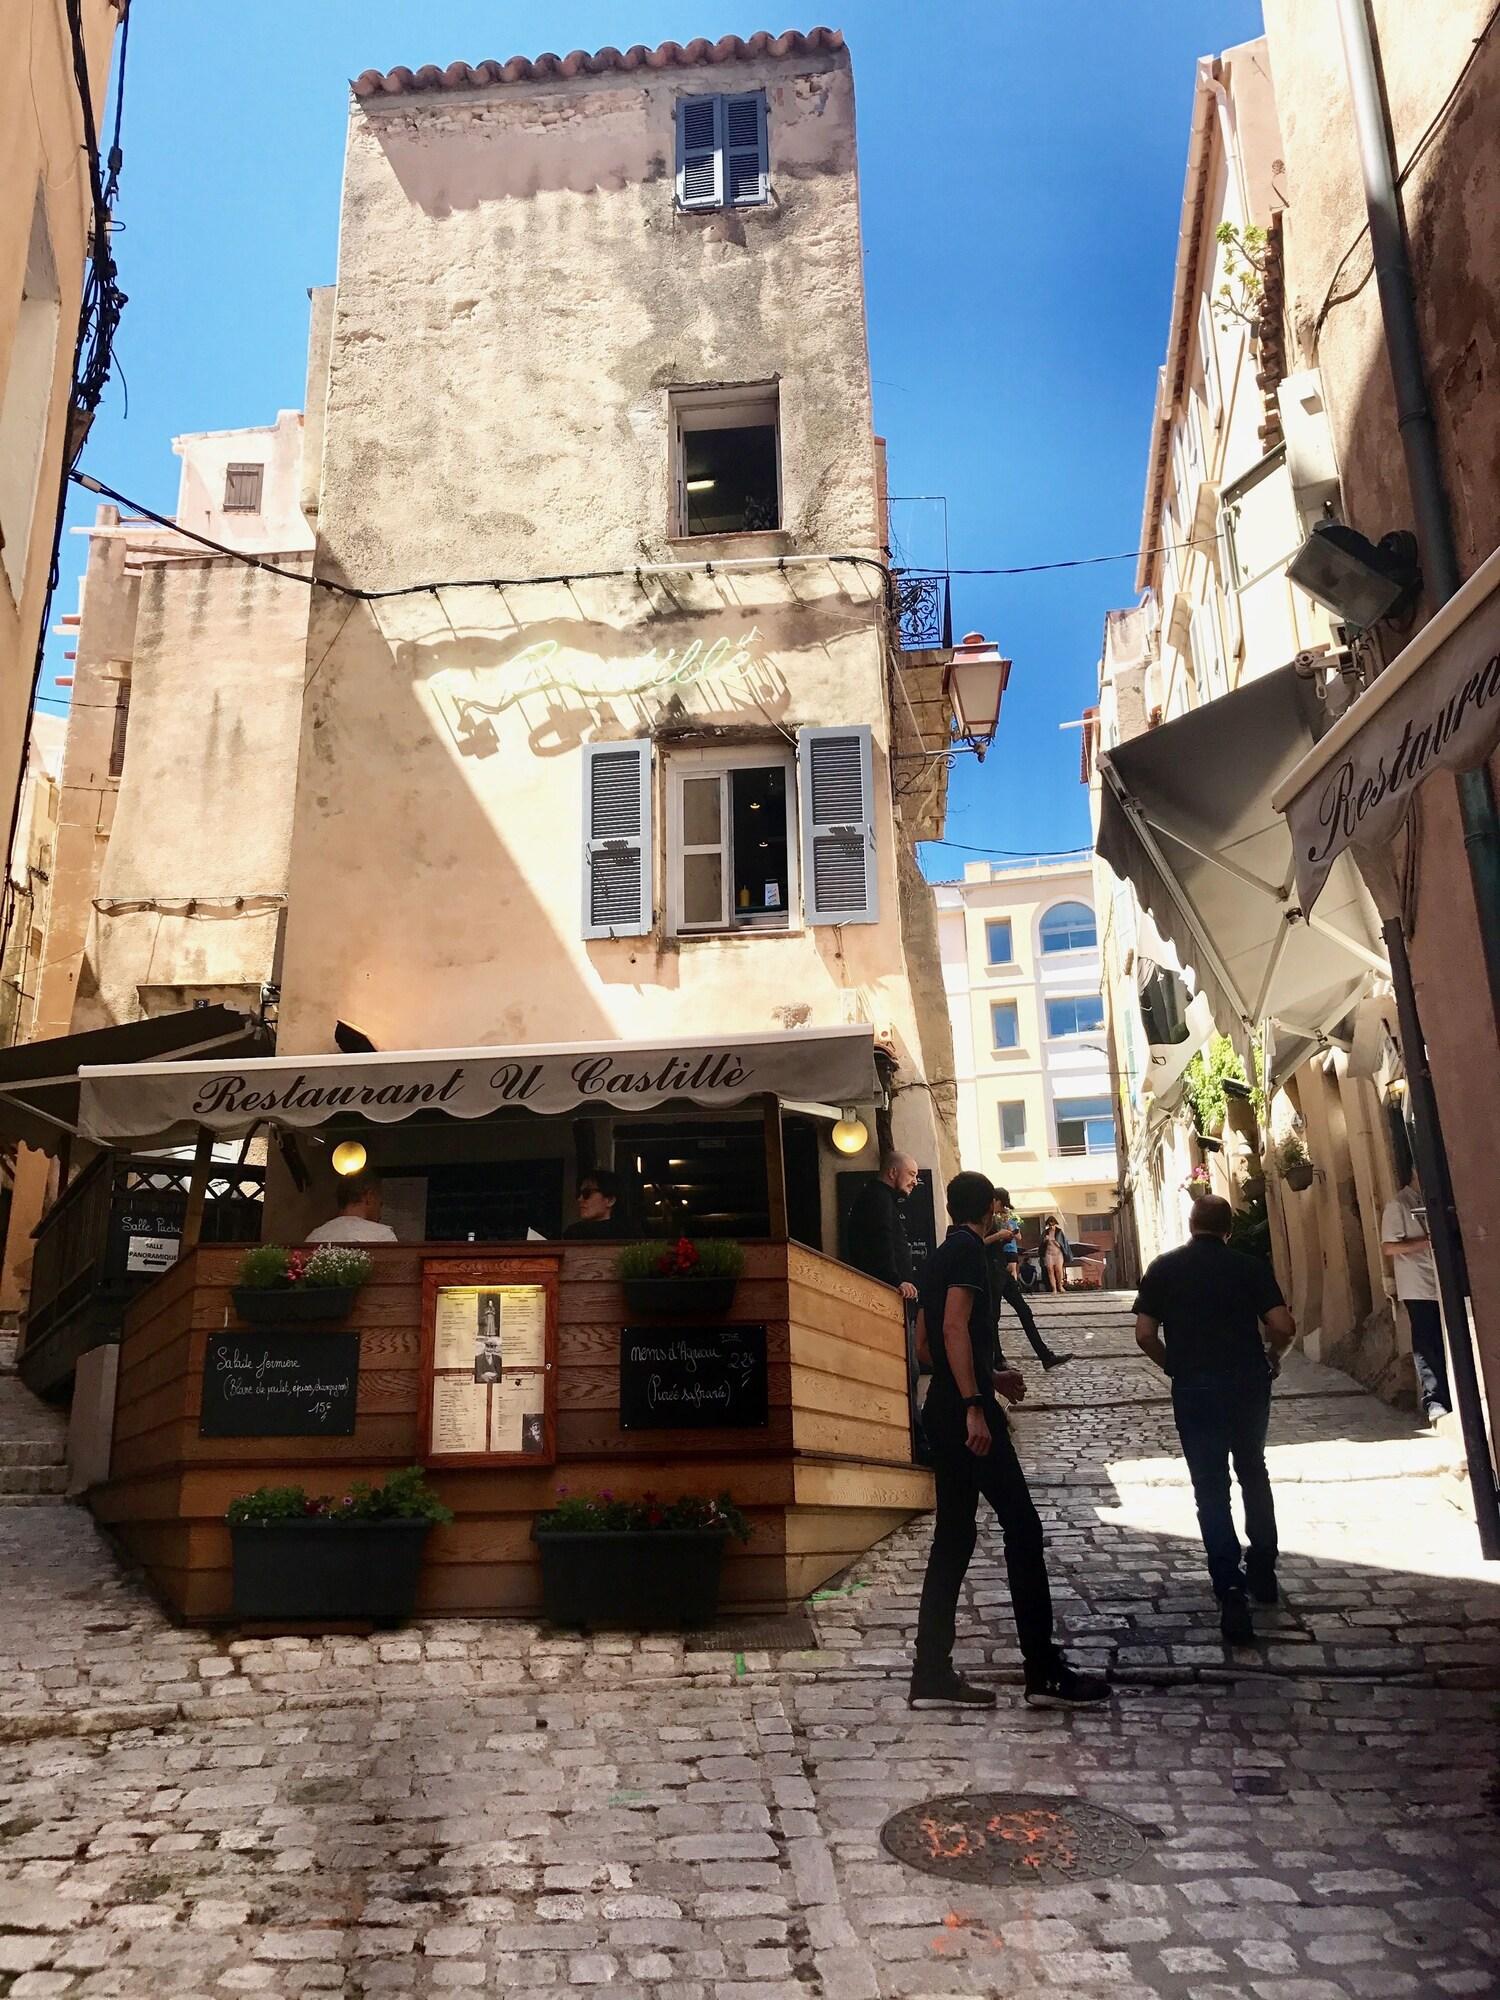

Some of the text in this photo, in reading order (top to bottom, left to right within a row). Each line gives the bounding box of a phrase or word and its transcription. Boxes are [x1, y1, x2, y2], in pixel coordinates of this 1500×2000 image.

[193, 1053, 755, 1114] Restaurant U Castillè
[121, 1216, 152, 1232] Salle
[145, 1242, 163, 1250] SALLE
[129, 1251, 177, 1261] PANORAMIQUE
